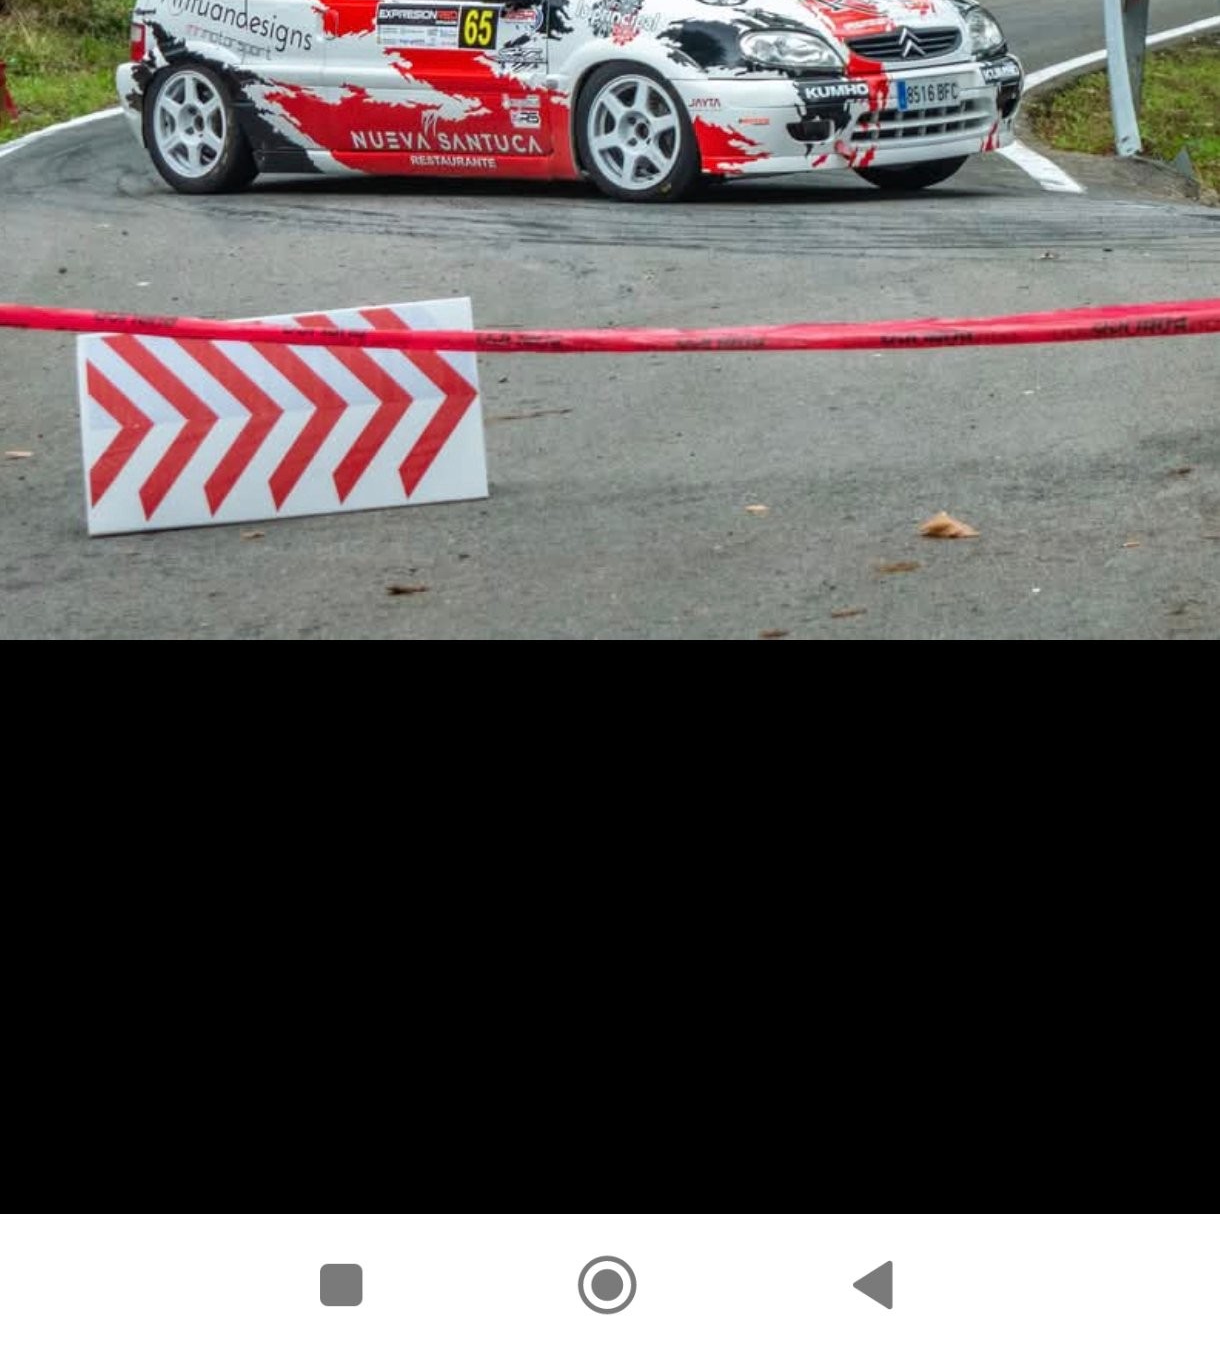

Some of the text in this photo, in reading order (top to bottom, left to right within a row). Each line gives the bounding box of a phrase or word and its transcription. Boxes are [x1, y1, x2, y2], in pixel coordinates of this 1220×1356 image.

[464, 8, 493, 46] 65
[804, 82, 869, 100] KUMHO
[906, 84, 935, 104] 8516
[350, 131, 543, 154] NUEVA SANTUCA
[410, 154, 497, 168] RESTAURANTE
